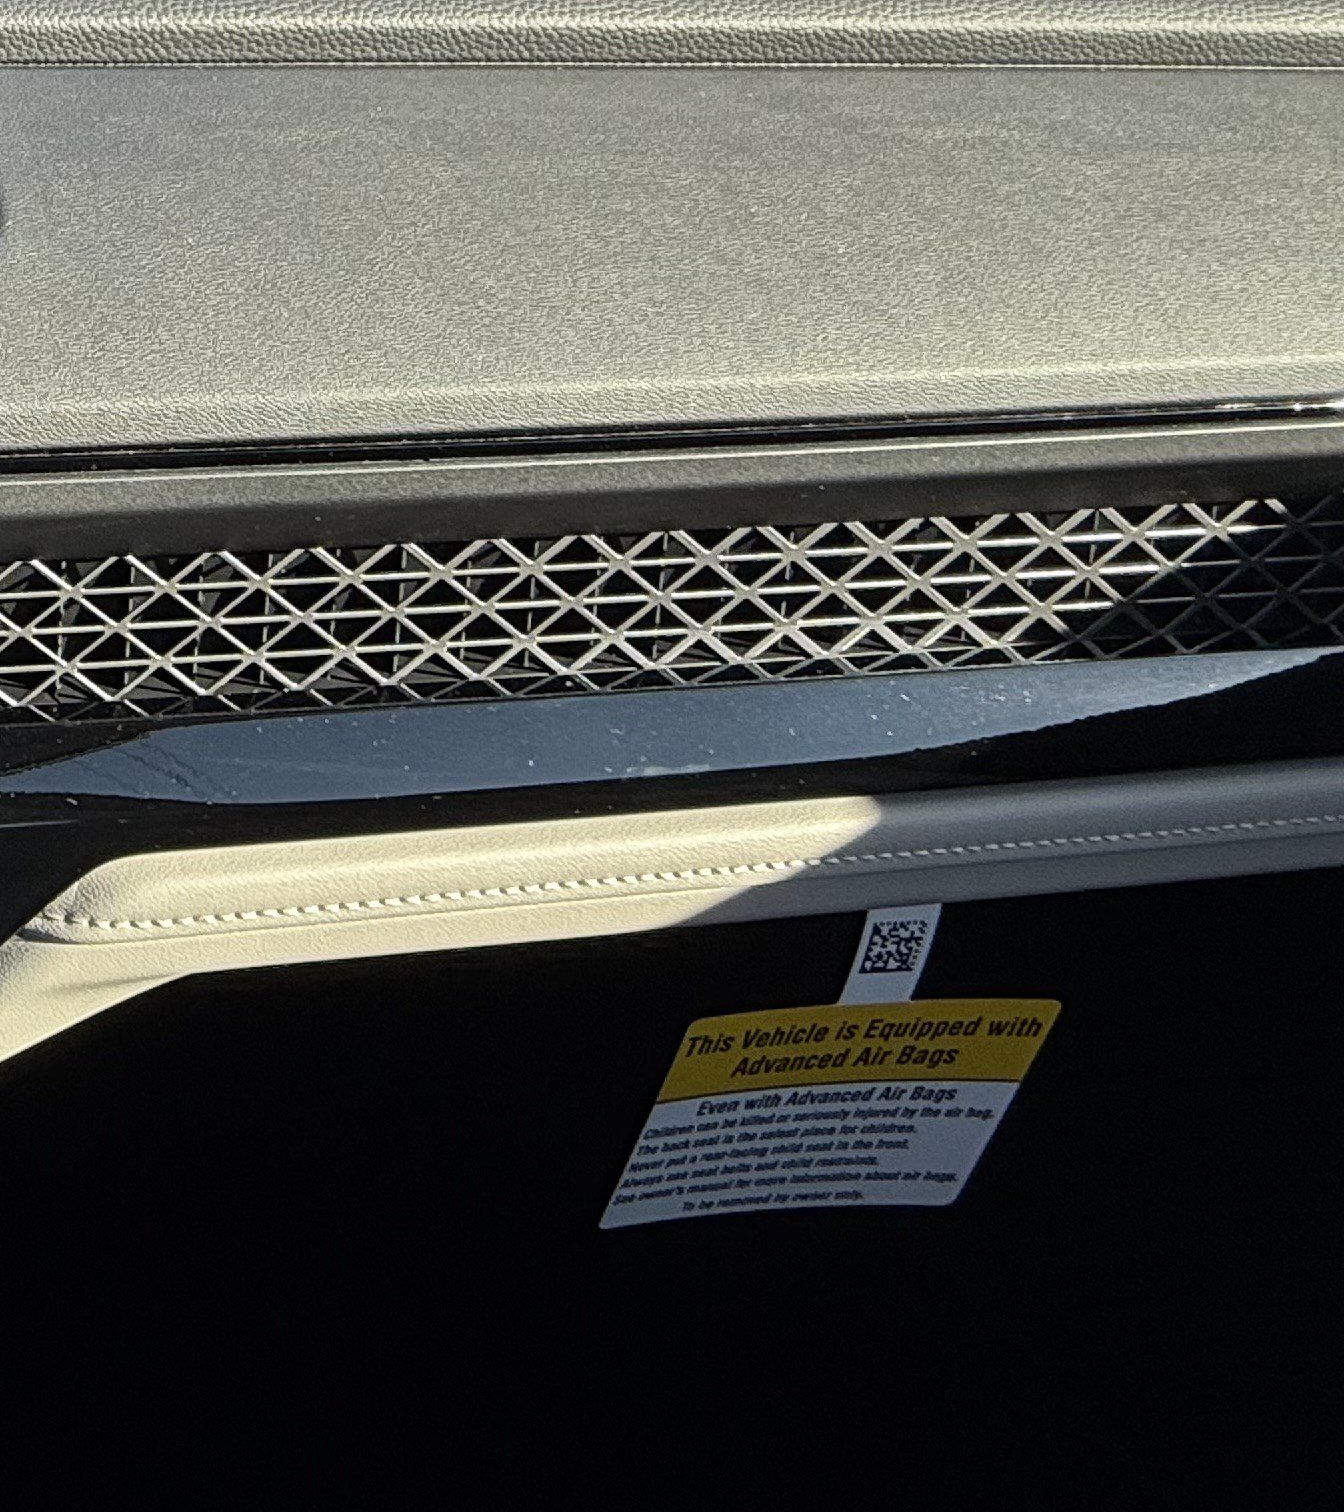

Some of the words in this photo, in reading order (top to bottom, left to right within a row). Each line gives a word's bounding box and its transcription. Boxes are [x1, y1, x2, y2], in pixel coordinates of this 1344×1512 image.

[686, 1035, 734, 1058] This
[742, 1023, 830, 1049] Vehicle
[836, 1020, 857, 1042] is
[864, 1015, 981, 1043] Equipped
[987, 1015, 1043, 1040] with
[730, 1049, 847, 1079] Advanced
[853, 1046, 893, 1068] Air
[896, 1045, 960, 1070] Bags
[695, 1100, 739, 1117] Even
[745, 1095, 783, 1112] with
[787, 1087, 878, 1106] Advanced
[882, 1086, 909, 1103] Air
[911, 1085, 959, 1105] Bags
